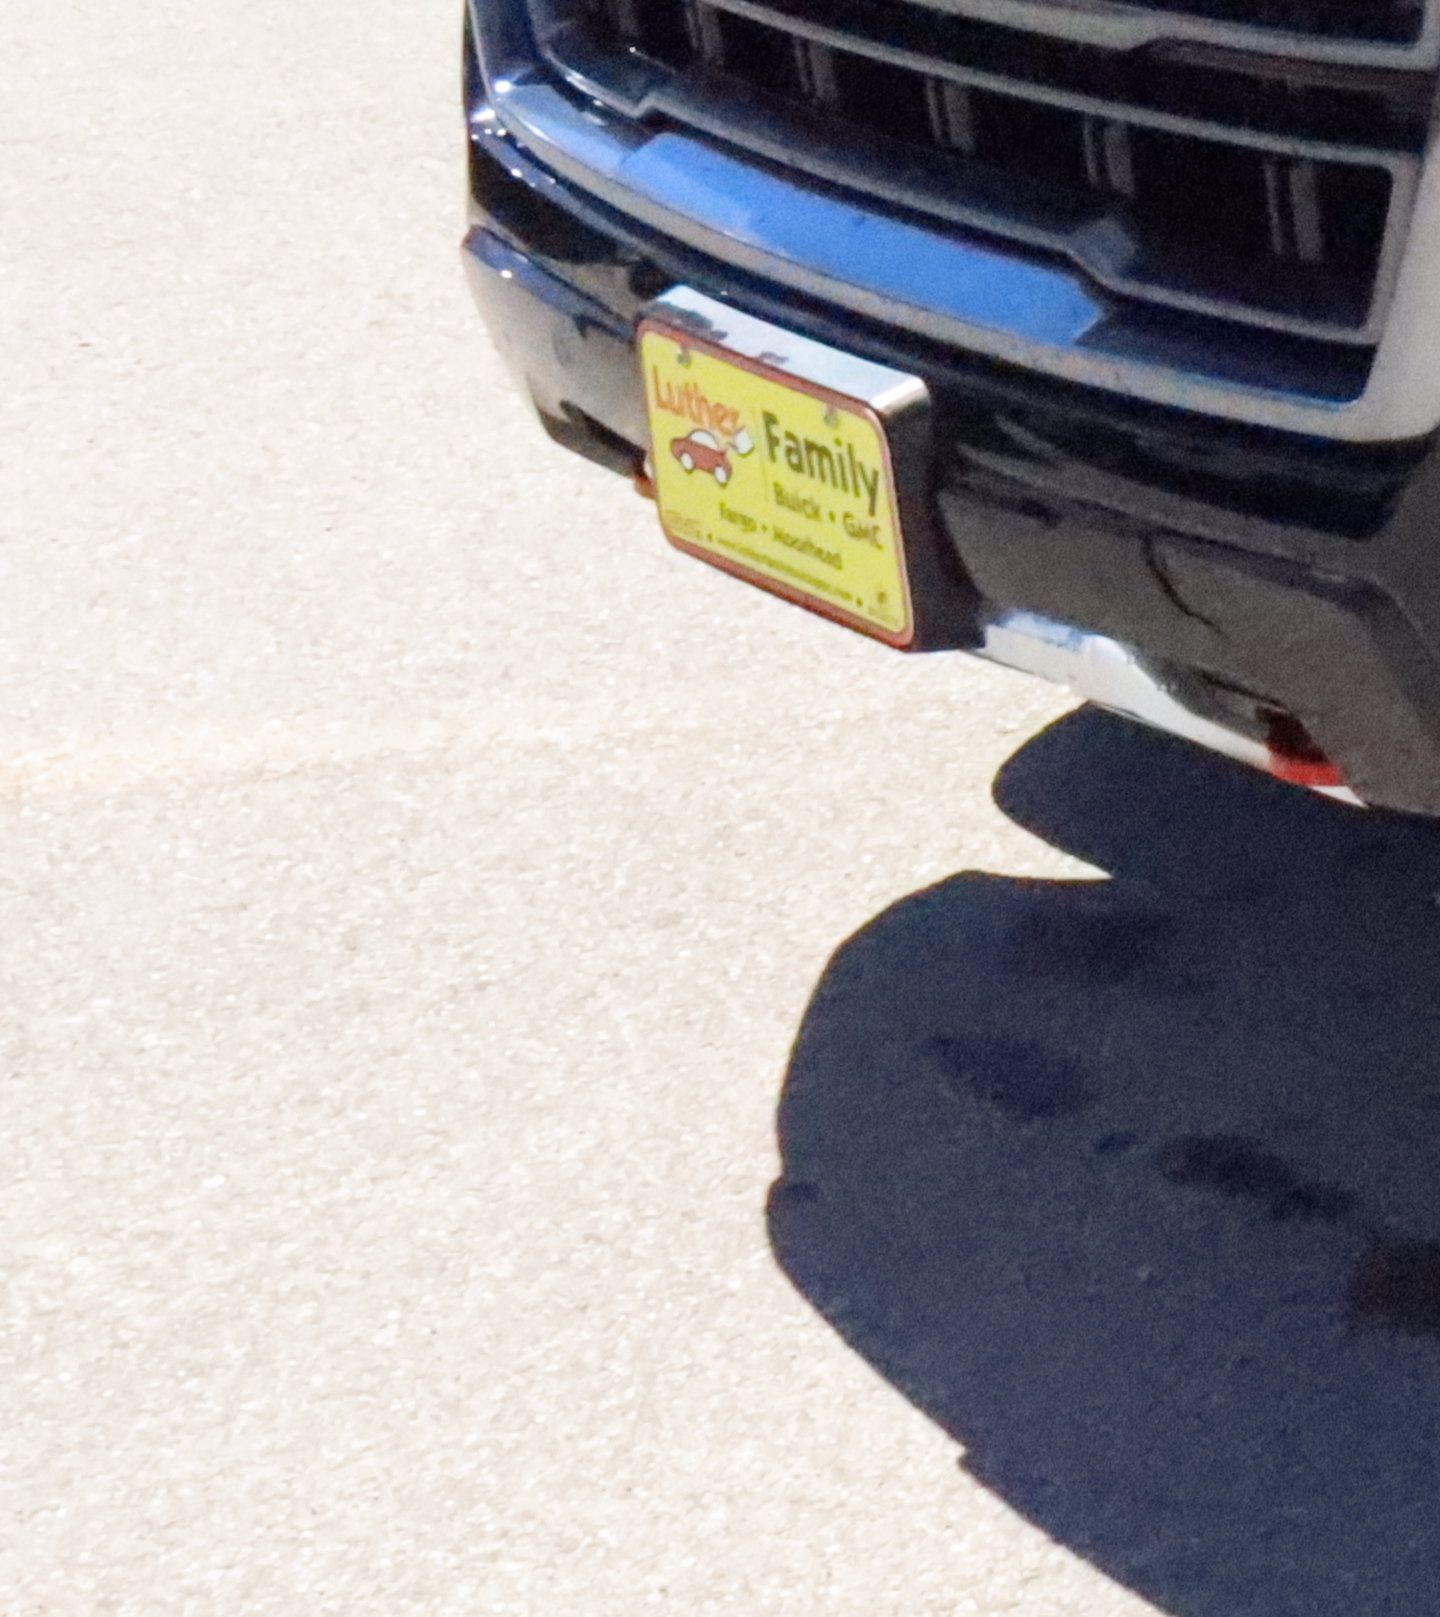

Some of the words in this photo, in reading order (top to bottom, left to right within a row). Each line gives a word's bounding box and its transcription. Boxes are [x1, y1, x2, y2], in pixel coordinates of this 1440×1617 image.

[651, 364, 740, 436] Luther
[762, 410, 879, 516] Family
[772, 481, 822, 521] Buick
[843, 511, 884, 550] GMC
